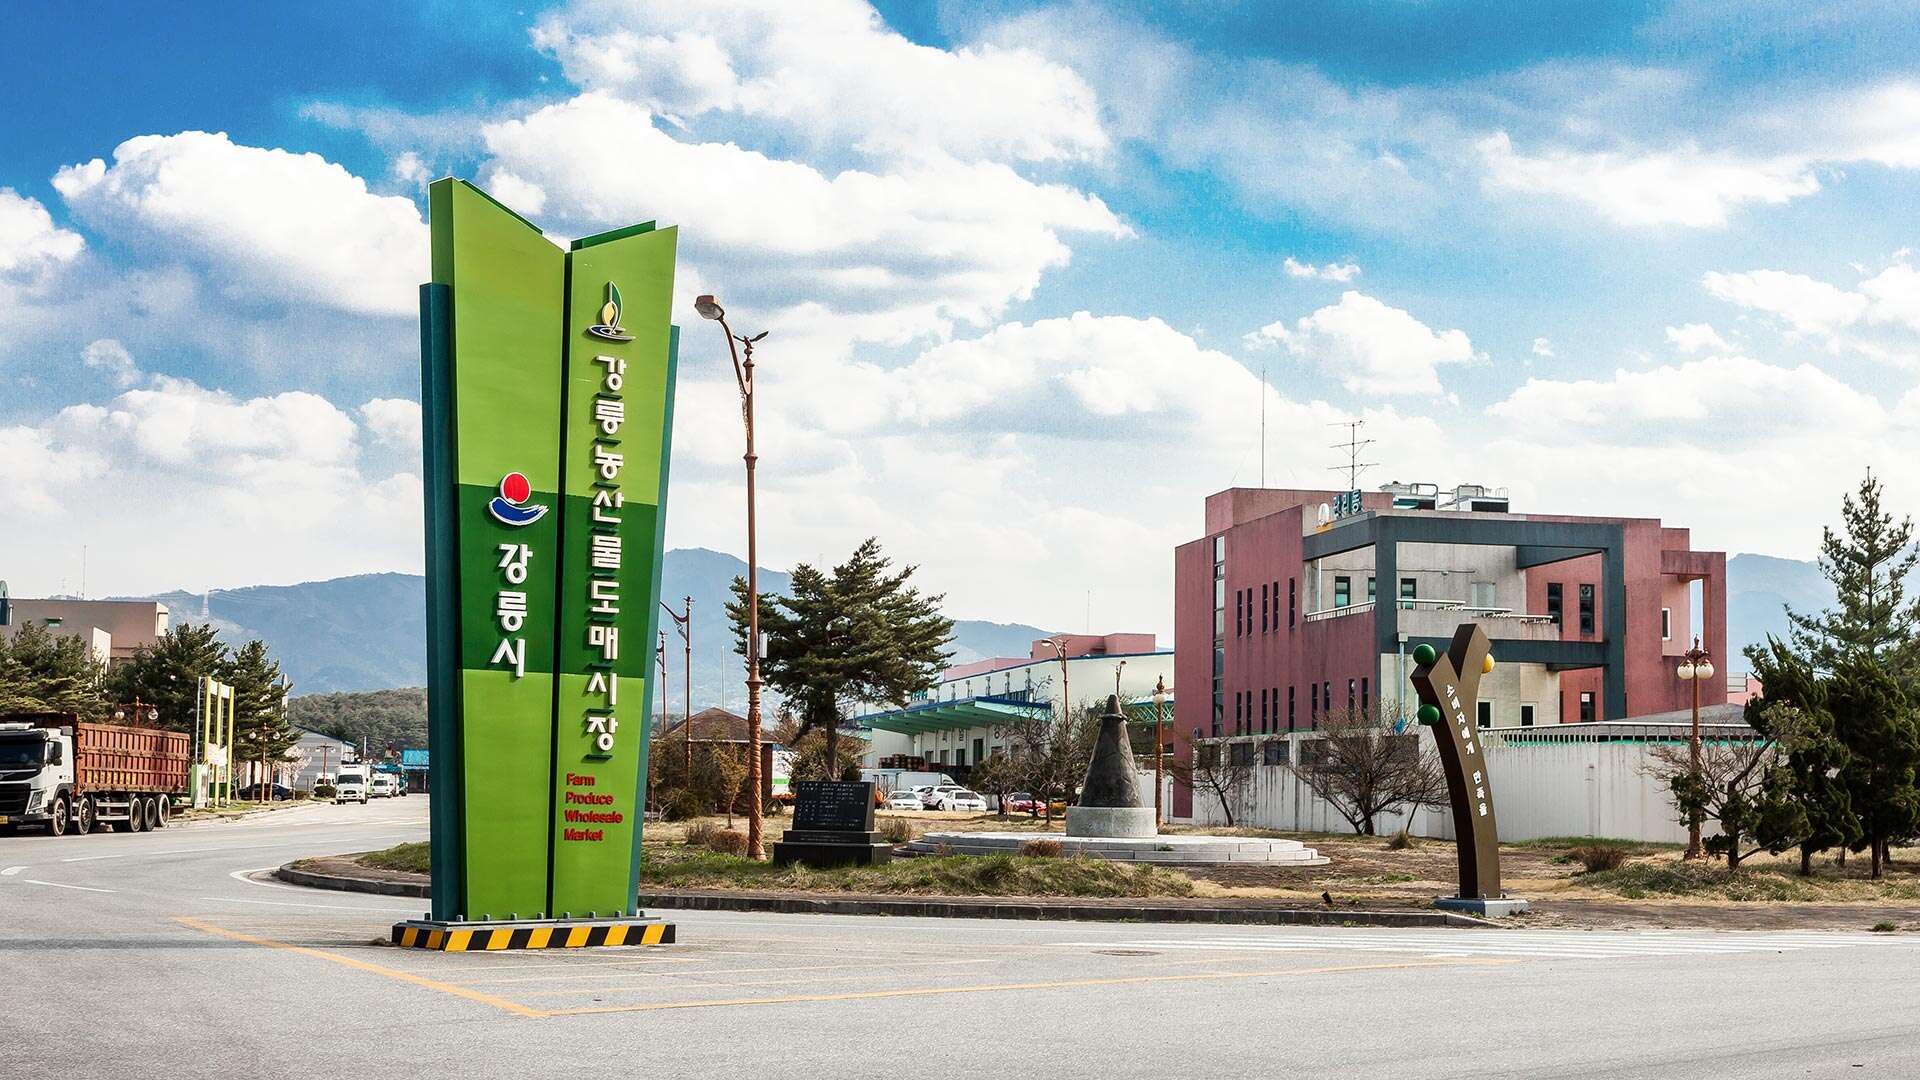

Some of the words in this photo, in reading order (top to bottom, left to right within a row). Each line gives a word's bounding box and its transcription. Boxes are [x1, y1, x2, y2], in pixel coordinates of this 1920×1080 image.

[586, 355, 627, 751] 강릉농산물도매시장
[491, 543, 533, 677] 강릉시
[1446, 684, 1475, 755] 소비자에게
[566, 772, 595, 786] Farm
[565, 791, 614, 805] Produce
[564, 809, 624, 824] Wholesale
[563, 828, 604, 841] Market
